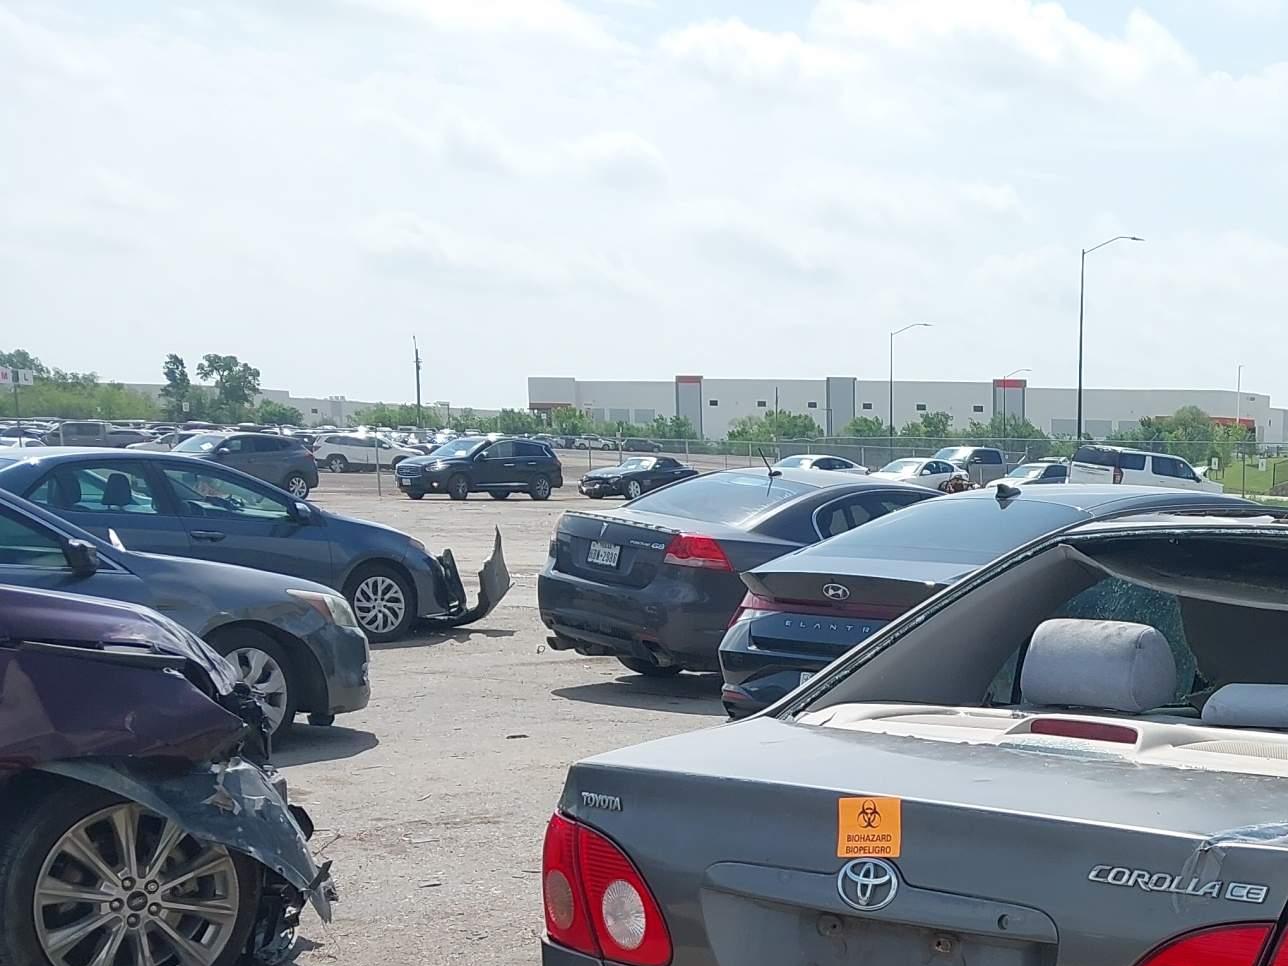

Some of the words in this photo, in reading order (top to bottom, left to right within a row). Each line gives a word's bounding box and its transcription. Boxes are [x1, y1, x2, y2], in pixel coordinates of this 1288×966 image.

[581, 791, 621, 811] TOYOTA
[846, 833, 893, 843] BIOHAZARD
[845, 845, 892, 855] BIOPELIGRO
[1088, 864, 1223, 898] COROLLA
[1226, 882, 1269, 904] CE
